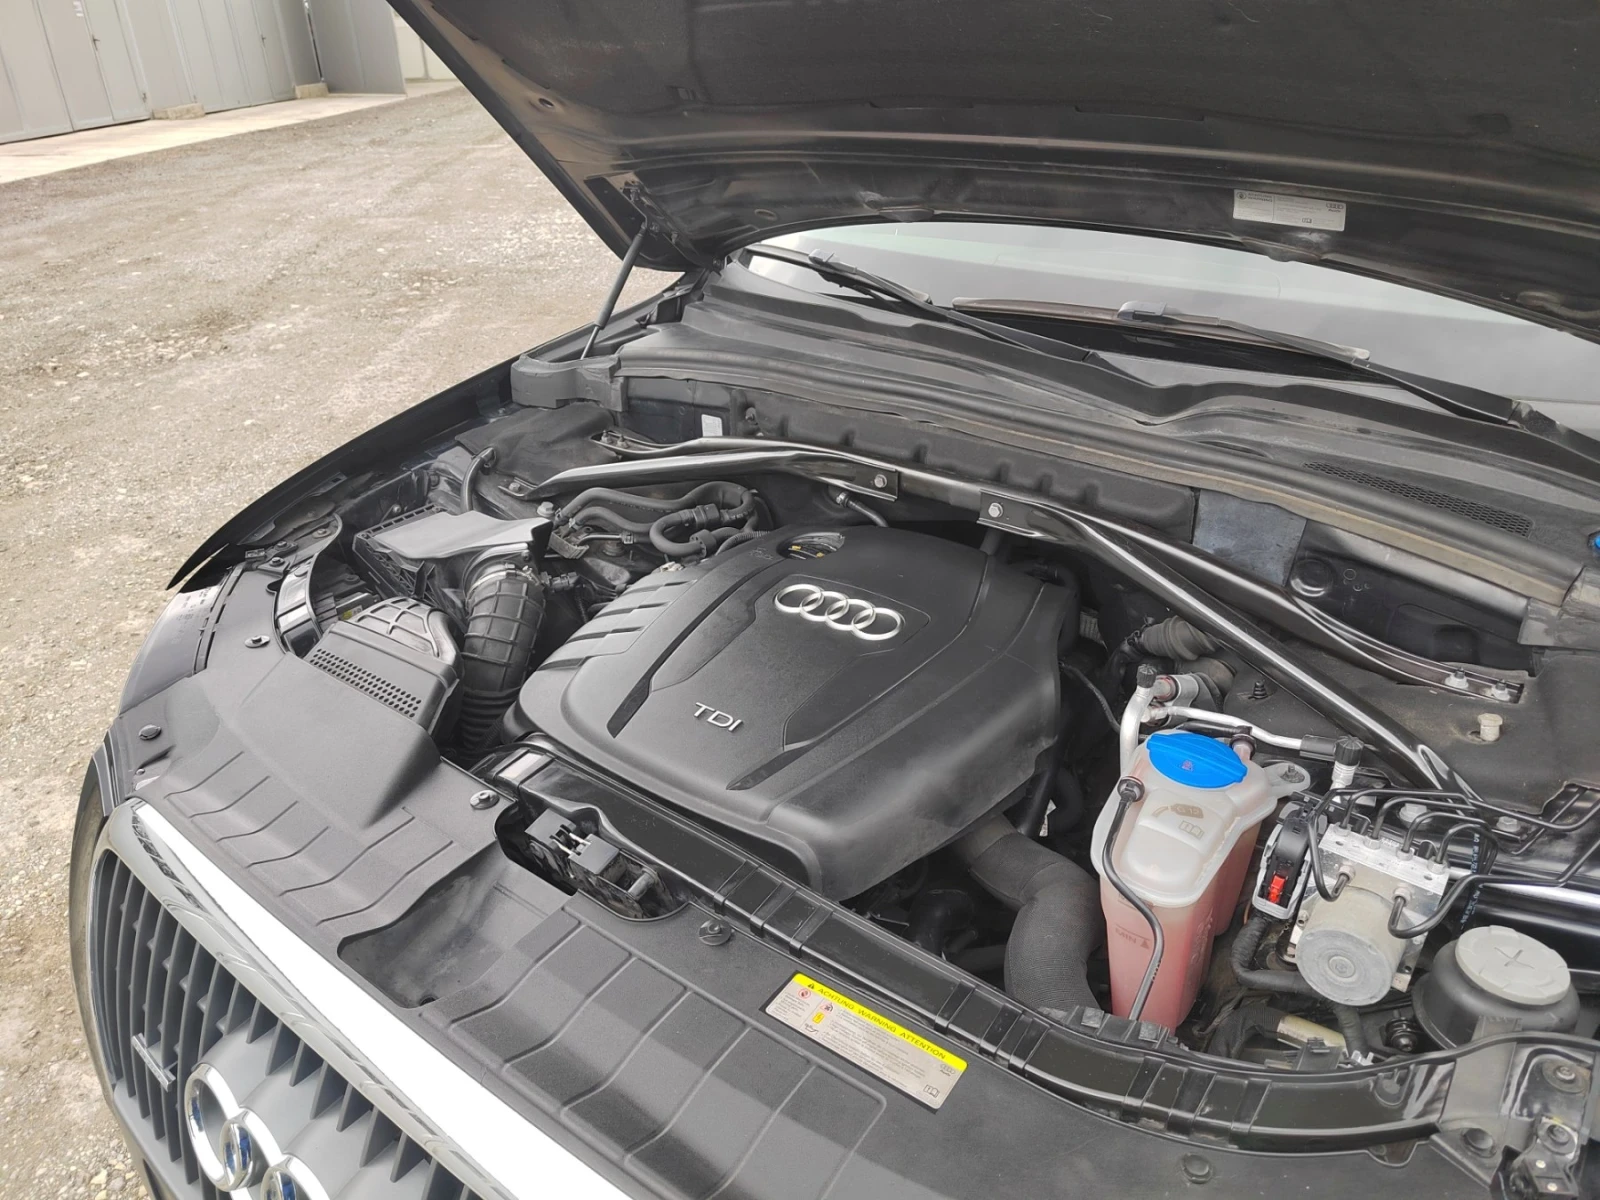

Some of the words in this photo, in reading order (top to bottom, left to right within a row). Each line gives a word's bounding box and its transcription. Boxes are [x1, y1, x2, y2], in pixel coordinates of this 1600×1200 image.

[693, 702, 742, 731] TDI
[1115, 927, 1137, 944] MIN
[818, 988, 855, 1010] ACHTUNG
[858, 1008, 897, 1033] WARNING
[900, 1032, 946, 1059] ATTENTION
